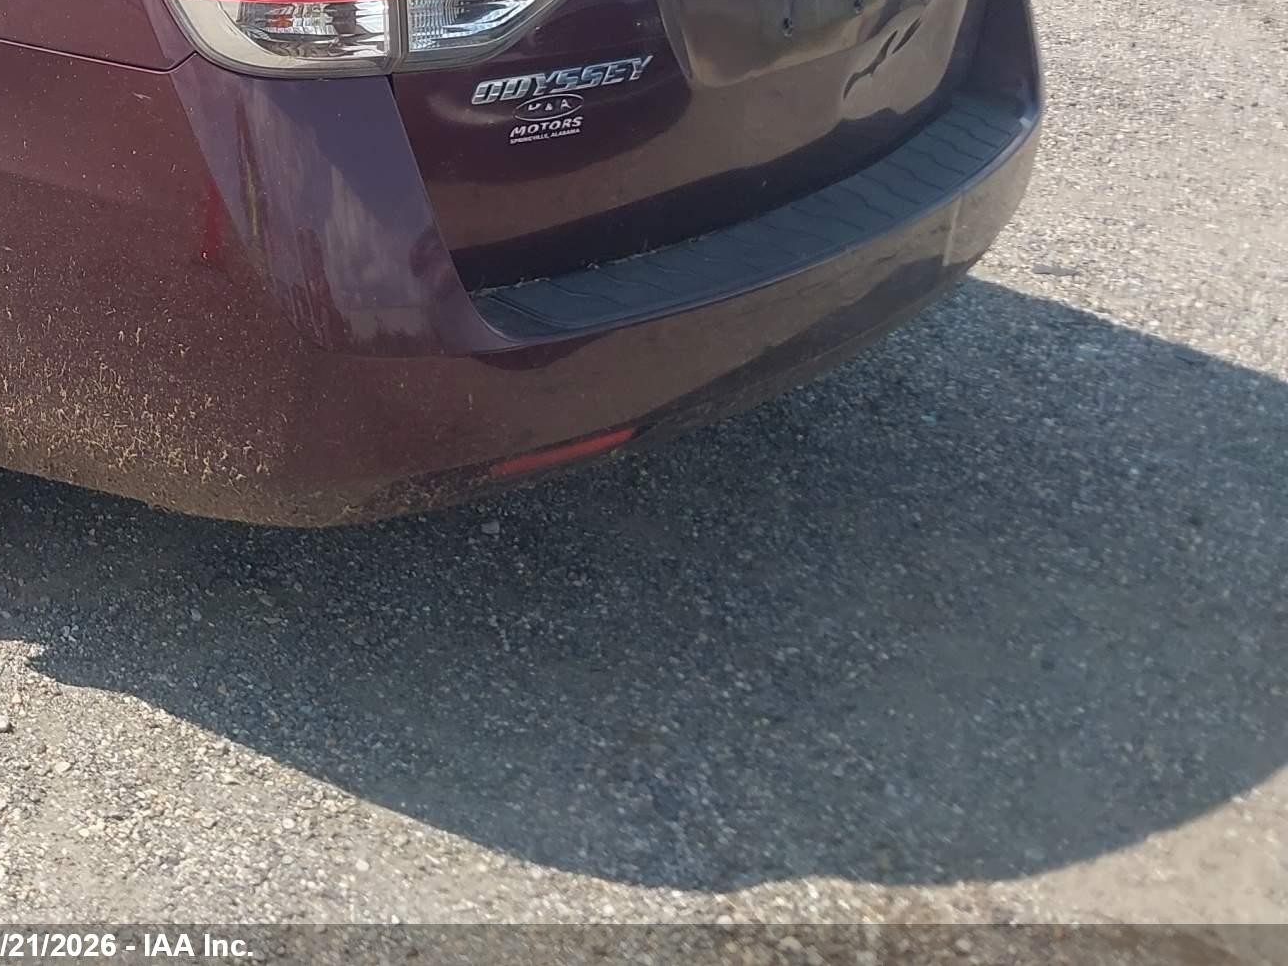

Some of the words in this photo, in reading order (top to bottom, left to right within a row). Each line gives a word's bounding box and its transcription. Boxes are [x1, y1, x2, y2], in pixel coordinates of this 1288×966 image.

[471, 54, 654, 105] ODYSSEY
[560, 98, 572, 109] A
[509, 116, 584, 138] MOTORS
